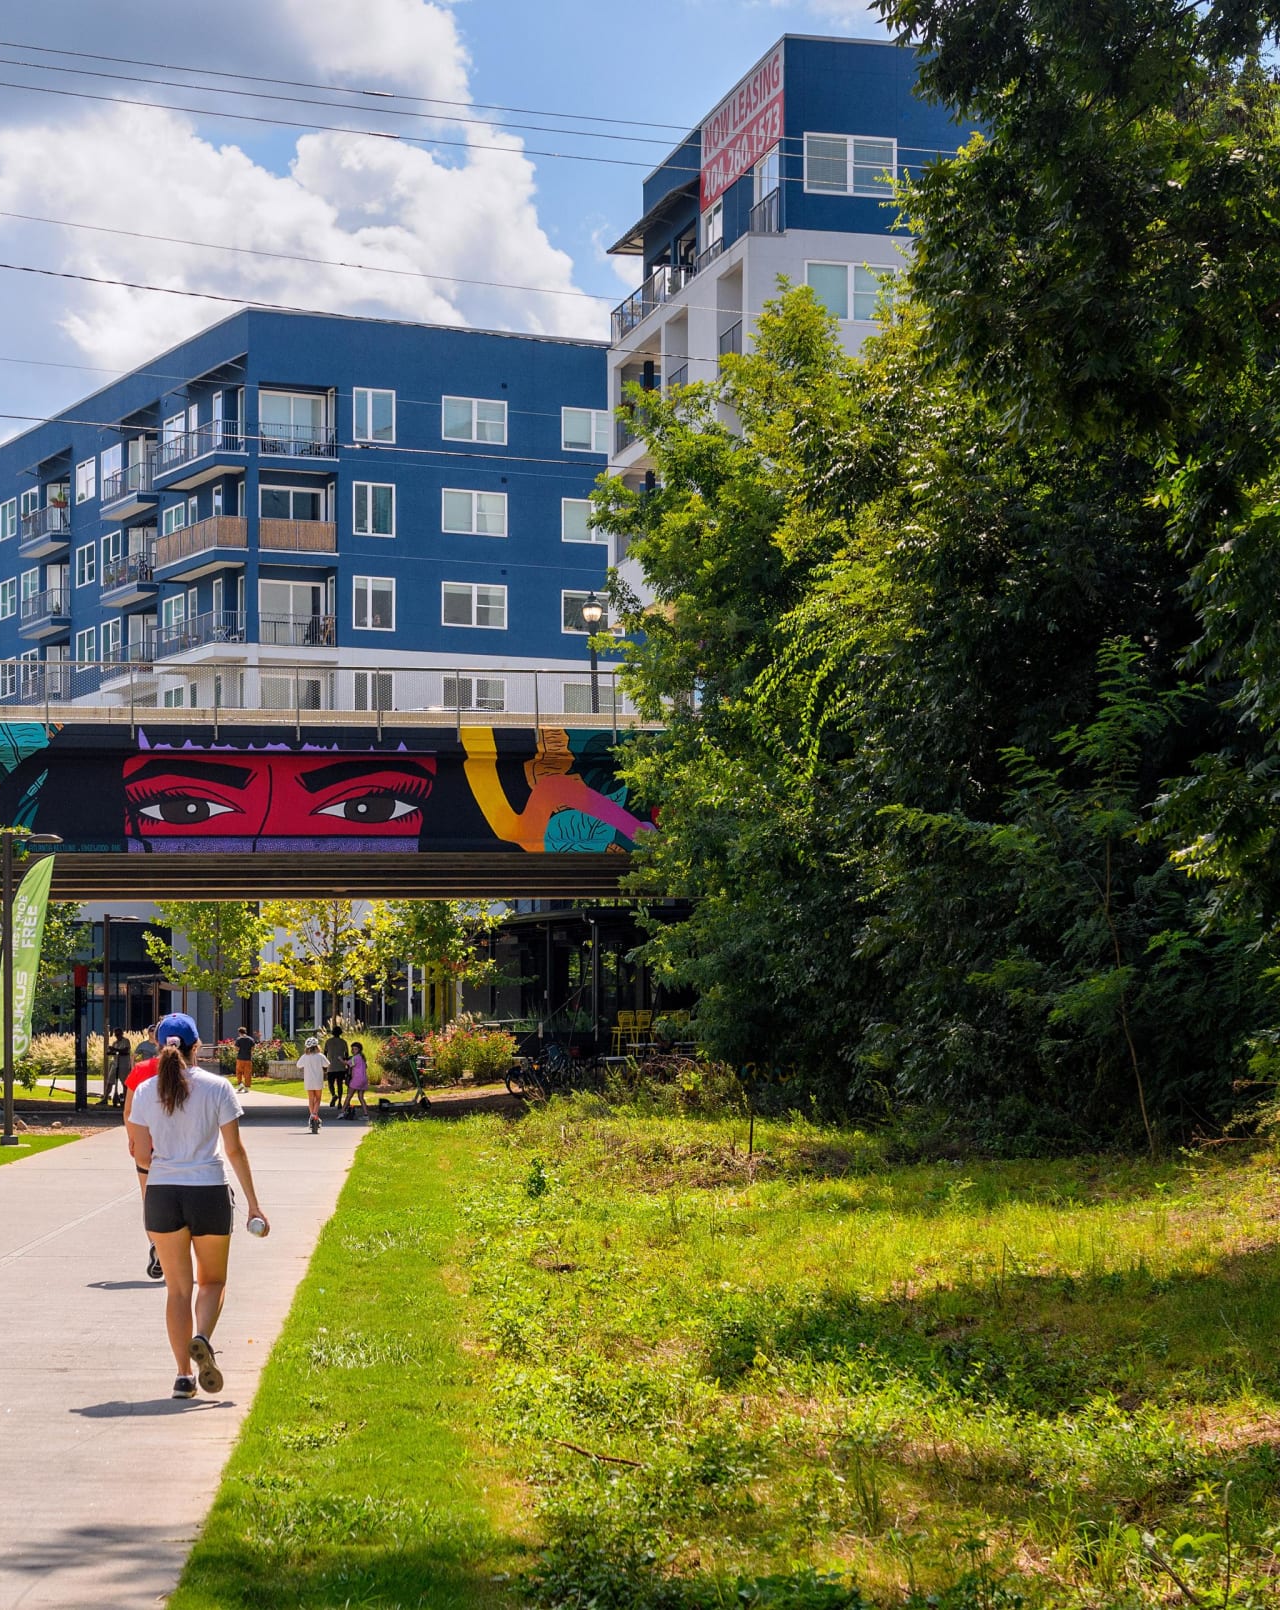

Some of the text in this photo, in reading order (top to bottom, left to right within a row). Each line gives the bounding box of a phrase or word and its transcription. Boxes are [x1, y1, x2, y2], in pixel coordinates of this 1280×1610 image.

[703, 53, 780, 158] NOW LEASING
[15, 894, 28, 922] RIDE
[21, 905, 39, 948] FREE
